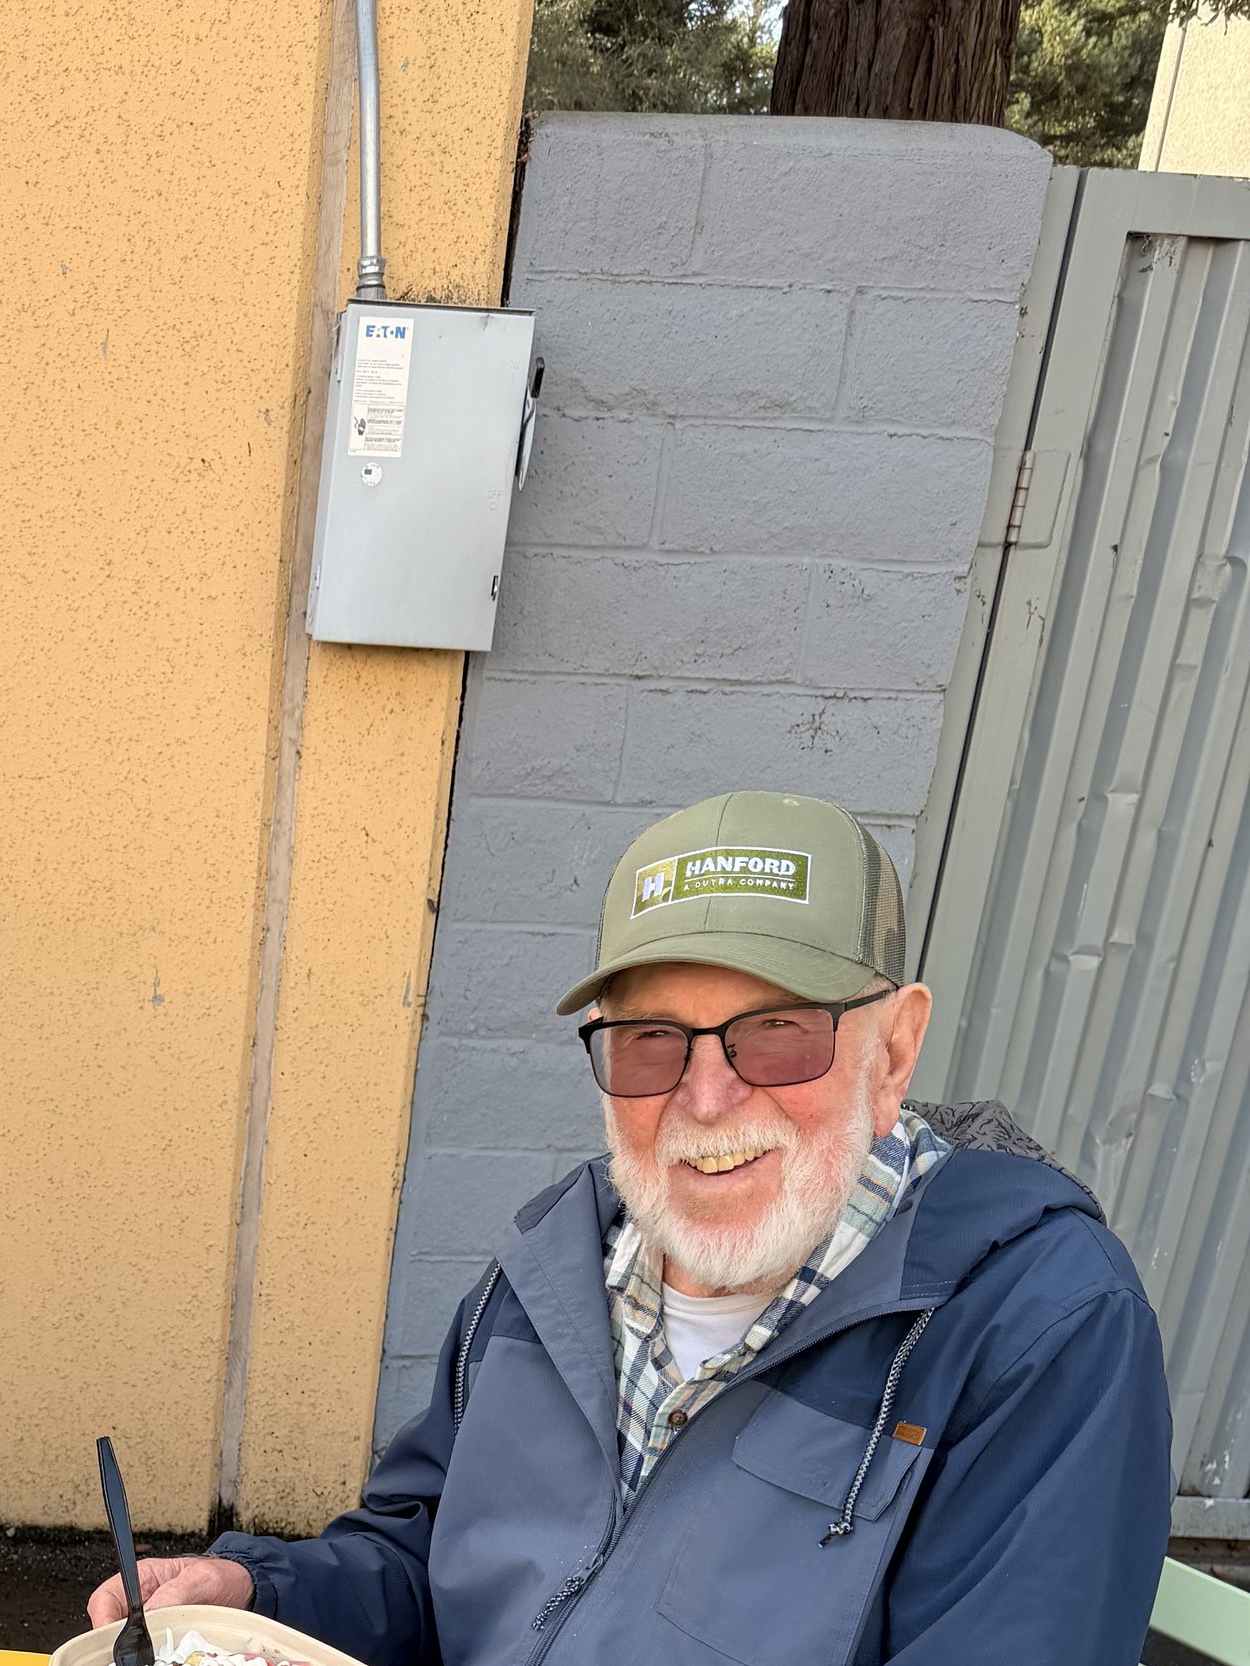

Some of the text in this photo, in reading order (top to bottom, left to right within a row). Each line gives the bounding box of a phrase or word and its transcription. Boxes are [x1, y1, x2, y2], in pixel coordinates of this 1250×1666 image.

[365, 325, 406, 339] EATON
[685, 856, 796, 877] HANFORD
[641, 872, 665, 902] H
[739, 878, 795, 890] COMPANY
